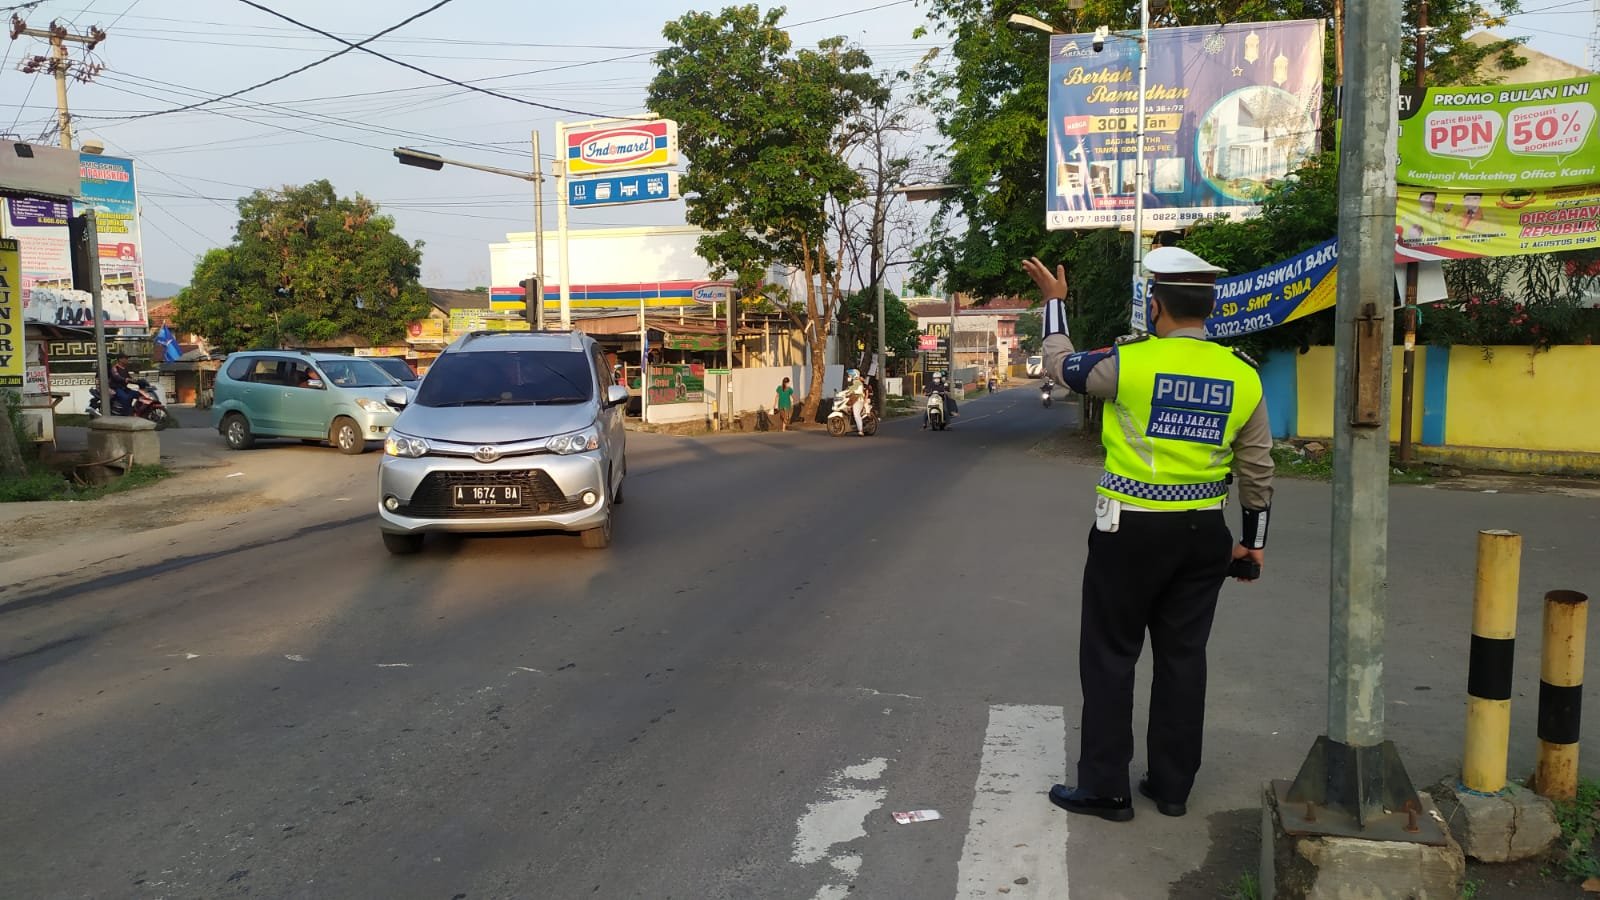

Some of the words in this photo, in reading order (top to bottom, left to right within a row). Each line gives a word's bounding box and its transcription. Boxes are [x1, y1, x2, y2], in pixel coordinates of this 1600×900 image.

[1063, 65, 1133, 86] Berkah
[1433, 92, 1495, 105] PROMO
[1498, 86, 1558, 103] BULAN
[1562, 82, 1590, 97] INI
[1398, 95, 1412, 111] EY
[1430, 117, 1456, 127] Gratis
[1458, 114, 1483, 124] Biaya
[1513, 107, 1557, 122] Discount
[1098, 118, 1127, 131] 300
[1513, 110, 1581, 146] 50%
[1431, 120, 1493, 150] PPN
[586, 138, 650, 158] Indomaret
[1524, 138, 1563, 152] BOOKING
[1408, 169, 1456, 182] Kunjungi
[1458, 171, 1517, 182] Marketing
[1520, 169, 1556, 180] Office
[1560, 165, 1595, 177] Kami
[1520, 204, 1600, 225] DIRGAHAY
[1519, 220, 1598, 238] REPUBLIK
[1532, 238, 1573, 248] AGUSTUS
[1576, 236, 1597, 245] 1945
[1222, 302, 1238, 317] SD
[1246, 292, 1273, 312] SMP
[1283, 277, 1312, 300] SMA
[1214, 313, 1274, 337] 2022-2023
[1157, 378, 1232, 407] POLISI
[1158, 411, 1185, 424] JAGA
[1185, 414, 1220, 428] JARAK
[1151, 422, 1181, 436] PAKAI
[1182, 427, 1221, 441] MASKER
[457, 487, 463, 499] A
[473, 487, 496, 499] 1674
[505, 487, 517, 499] BA
